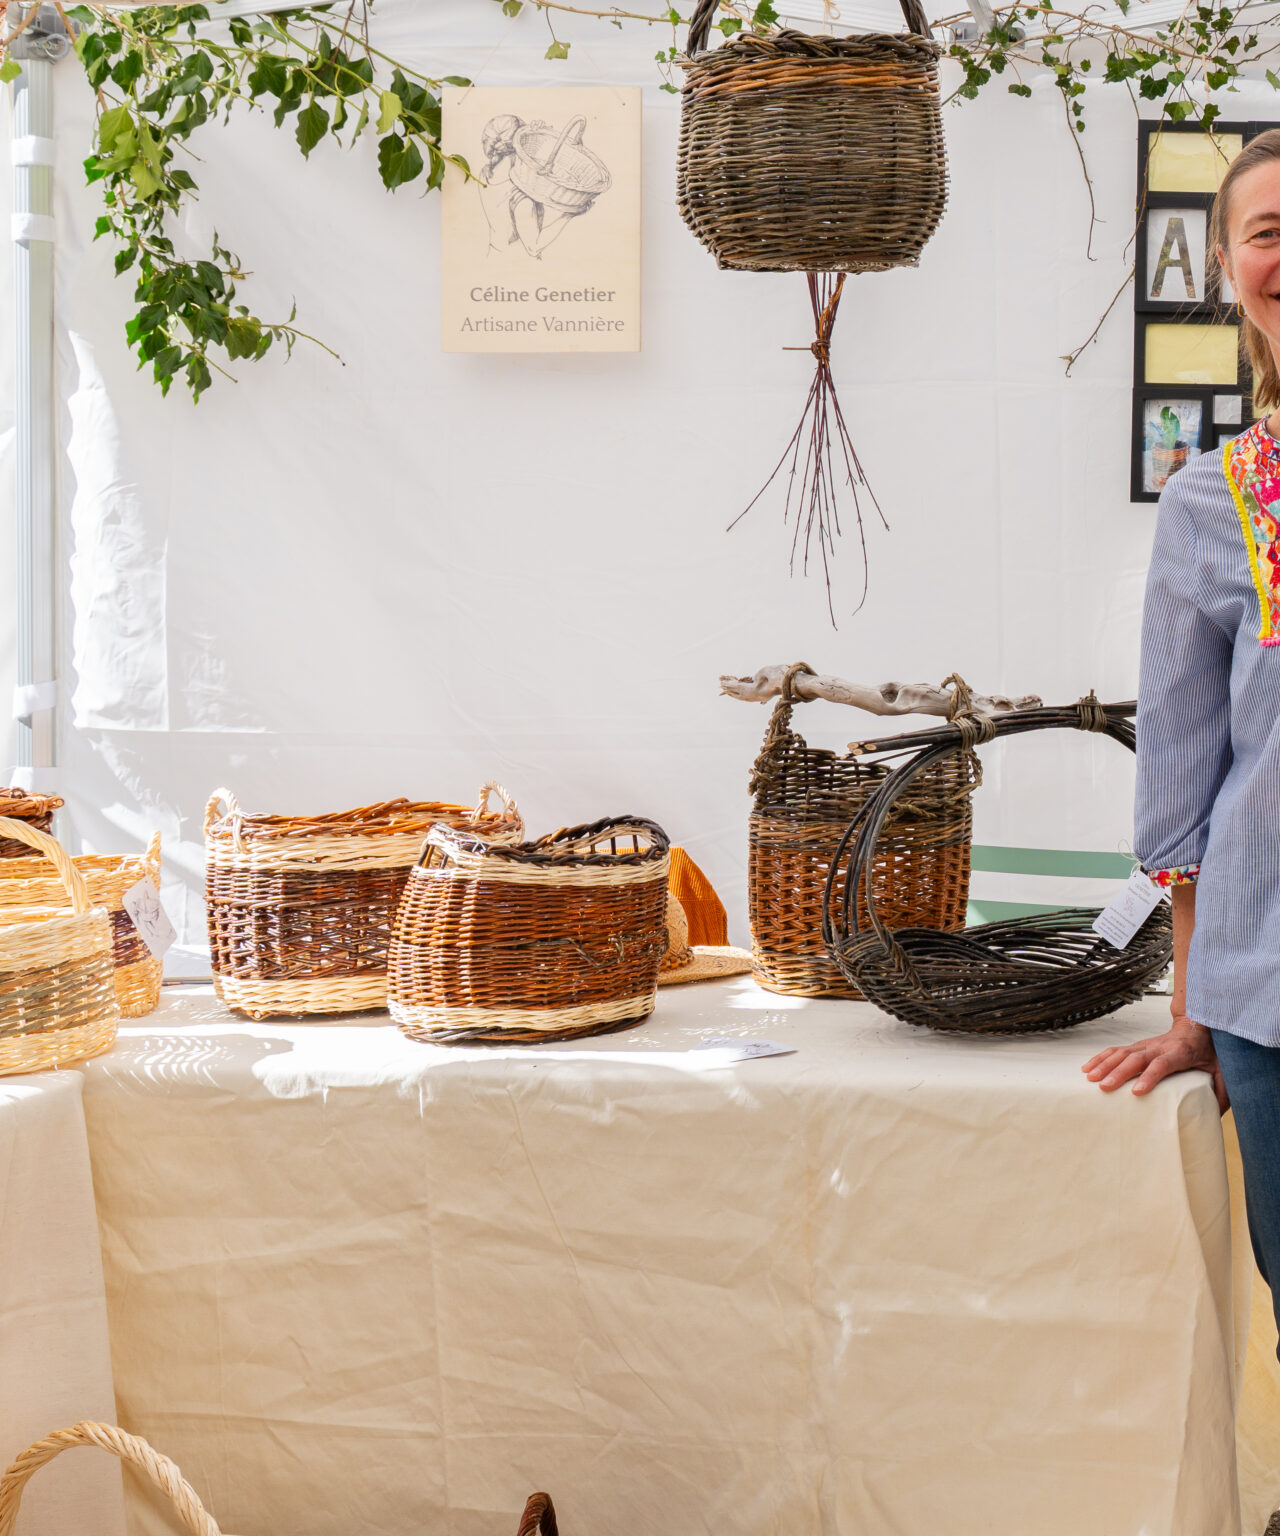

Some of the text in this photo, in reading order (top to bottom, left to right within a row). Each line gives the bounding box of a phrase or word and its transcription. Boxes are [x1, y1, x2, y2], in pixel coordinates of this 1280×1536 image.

[470, 286, 616, 302] Céline Genetier
[461, 315, 625, 332] Artisane Vannière
